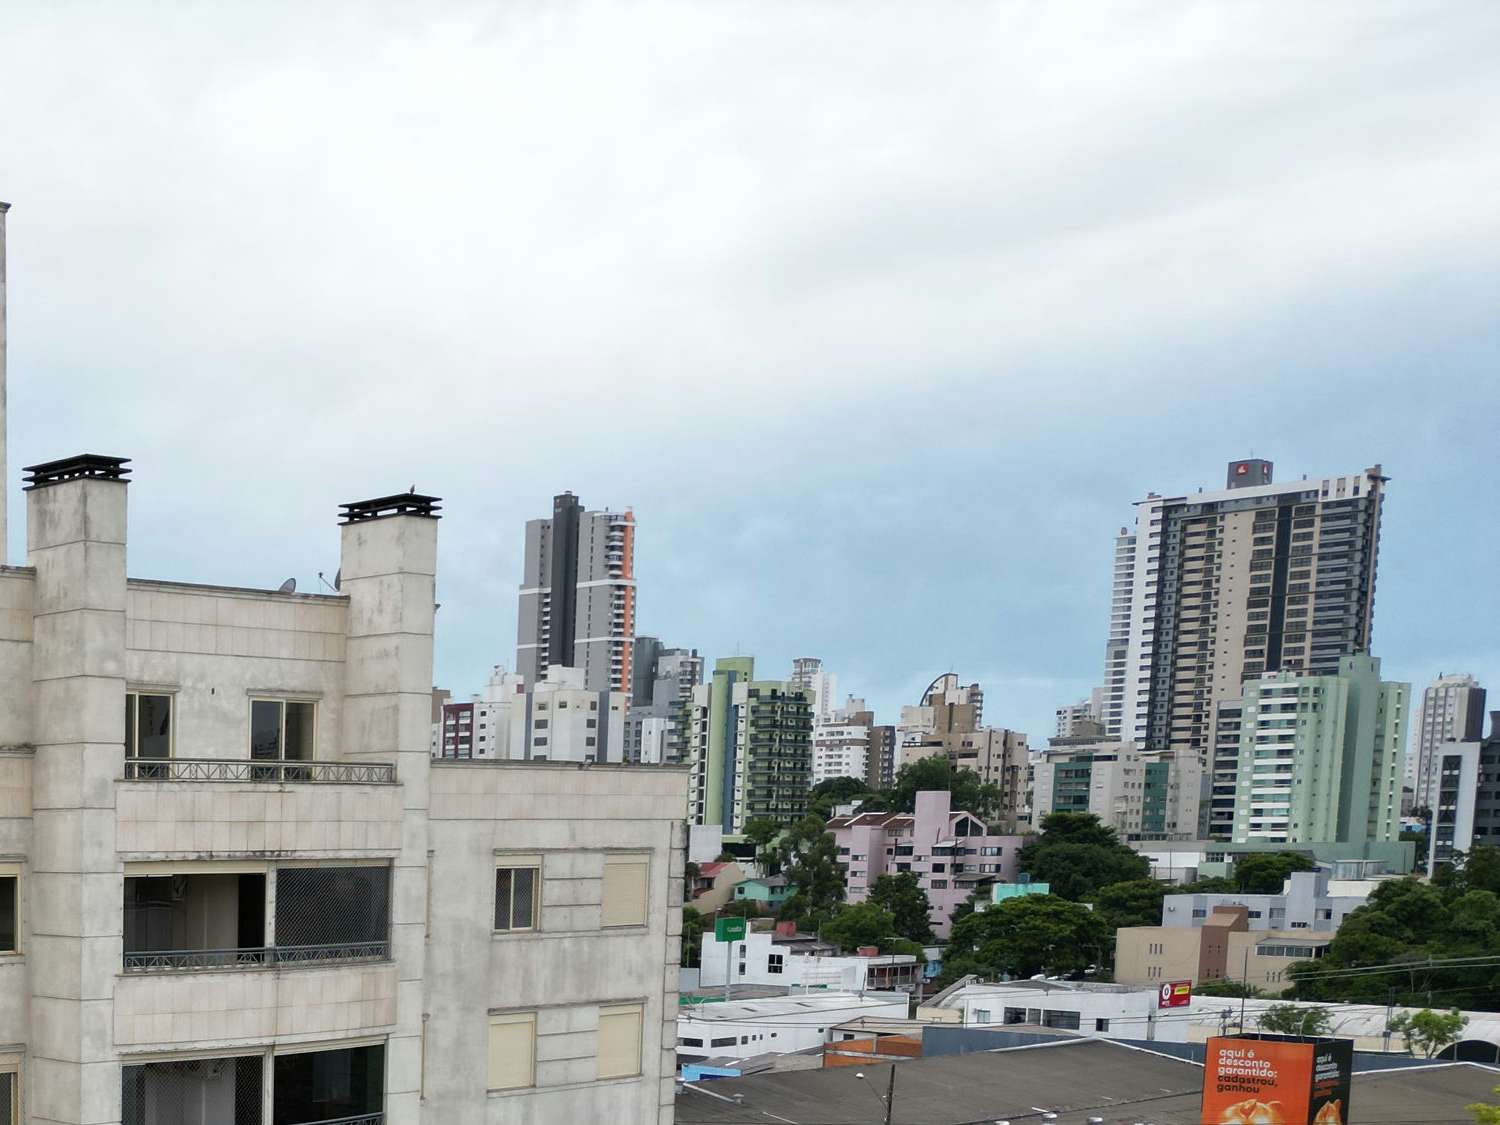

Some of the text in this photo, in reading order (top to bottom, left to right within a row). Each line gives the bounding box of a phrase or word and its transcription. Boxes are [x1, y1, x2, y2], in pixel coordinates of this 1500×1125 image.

[1219, 1049, 1255, 1059] aqui é
[1218, 1057, 1271, 1068] desconto
[1218, 1066, 1278, 1078] garantido:
[1217, 1074, 1278, 1087] cadastrou,
[1217, 1084, 1260, 1094] ganhou
